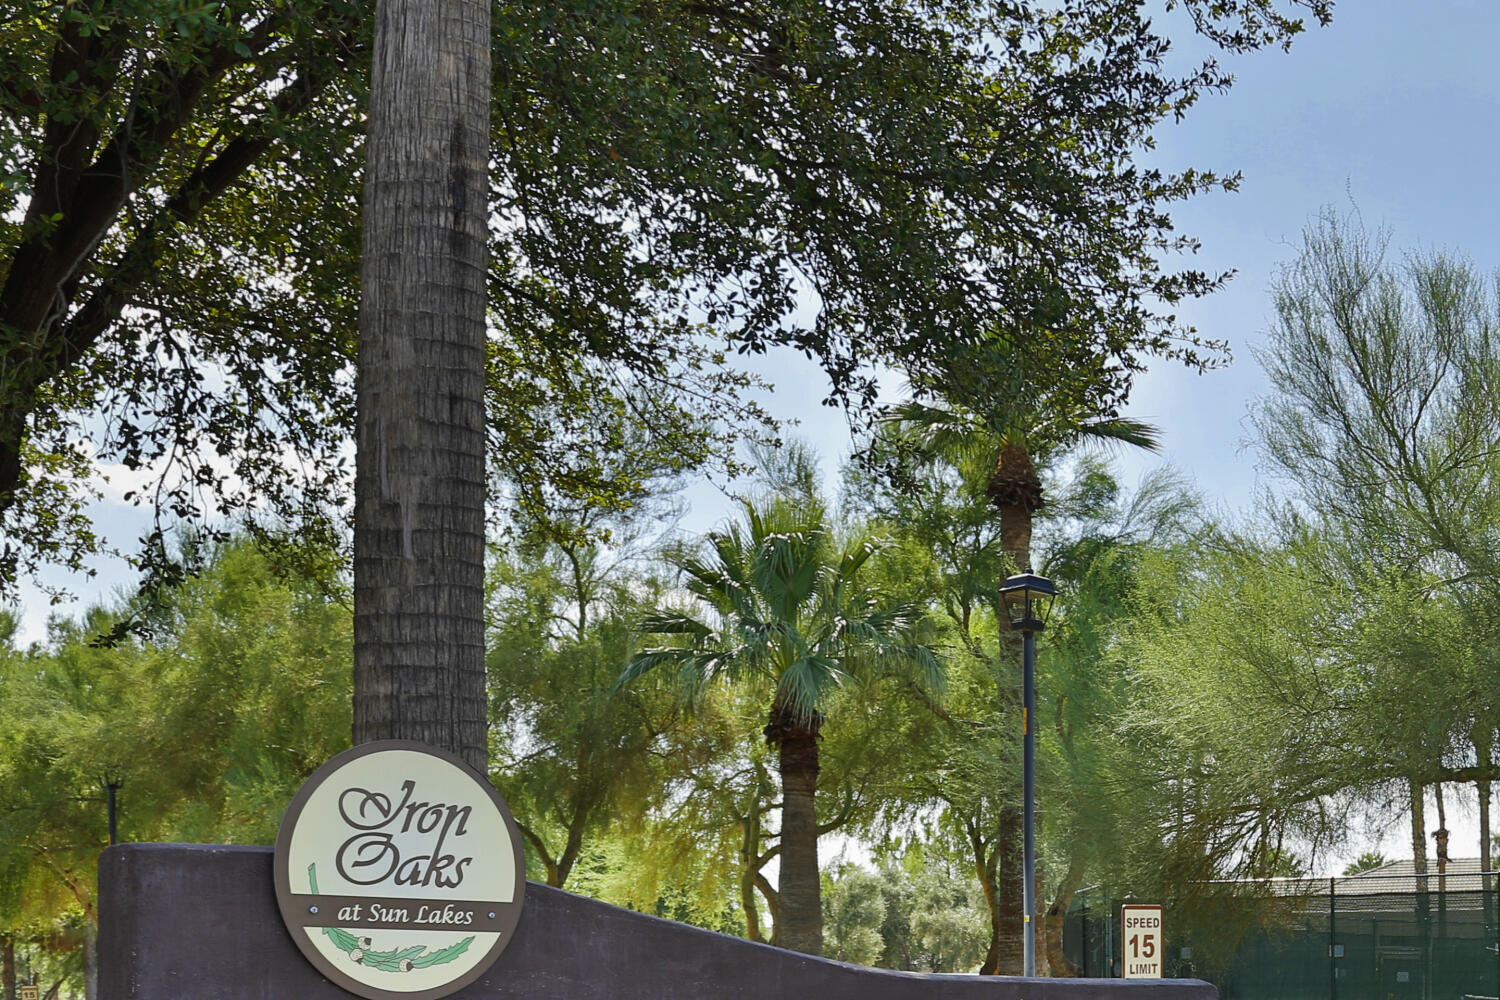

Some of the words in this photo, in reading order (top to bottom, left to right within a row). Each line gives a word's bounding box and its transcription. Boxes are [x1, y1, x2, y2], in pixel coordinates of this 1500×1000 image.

[338, 779, 473, 836] Iron
[335, 832, 473, 888] Oaks
[338, 905, 362, 921] at
[368, 904, 409, 923] Sun
[414, 904, 473, 925] Lakes
[1126, 918, 1160, 928] SPEED
[1129, 934, 1155, 958] 15
[1130, 963, 1158, 975] LIMIT
